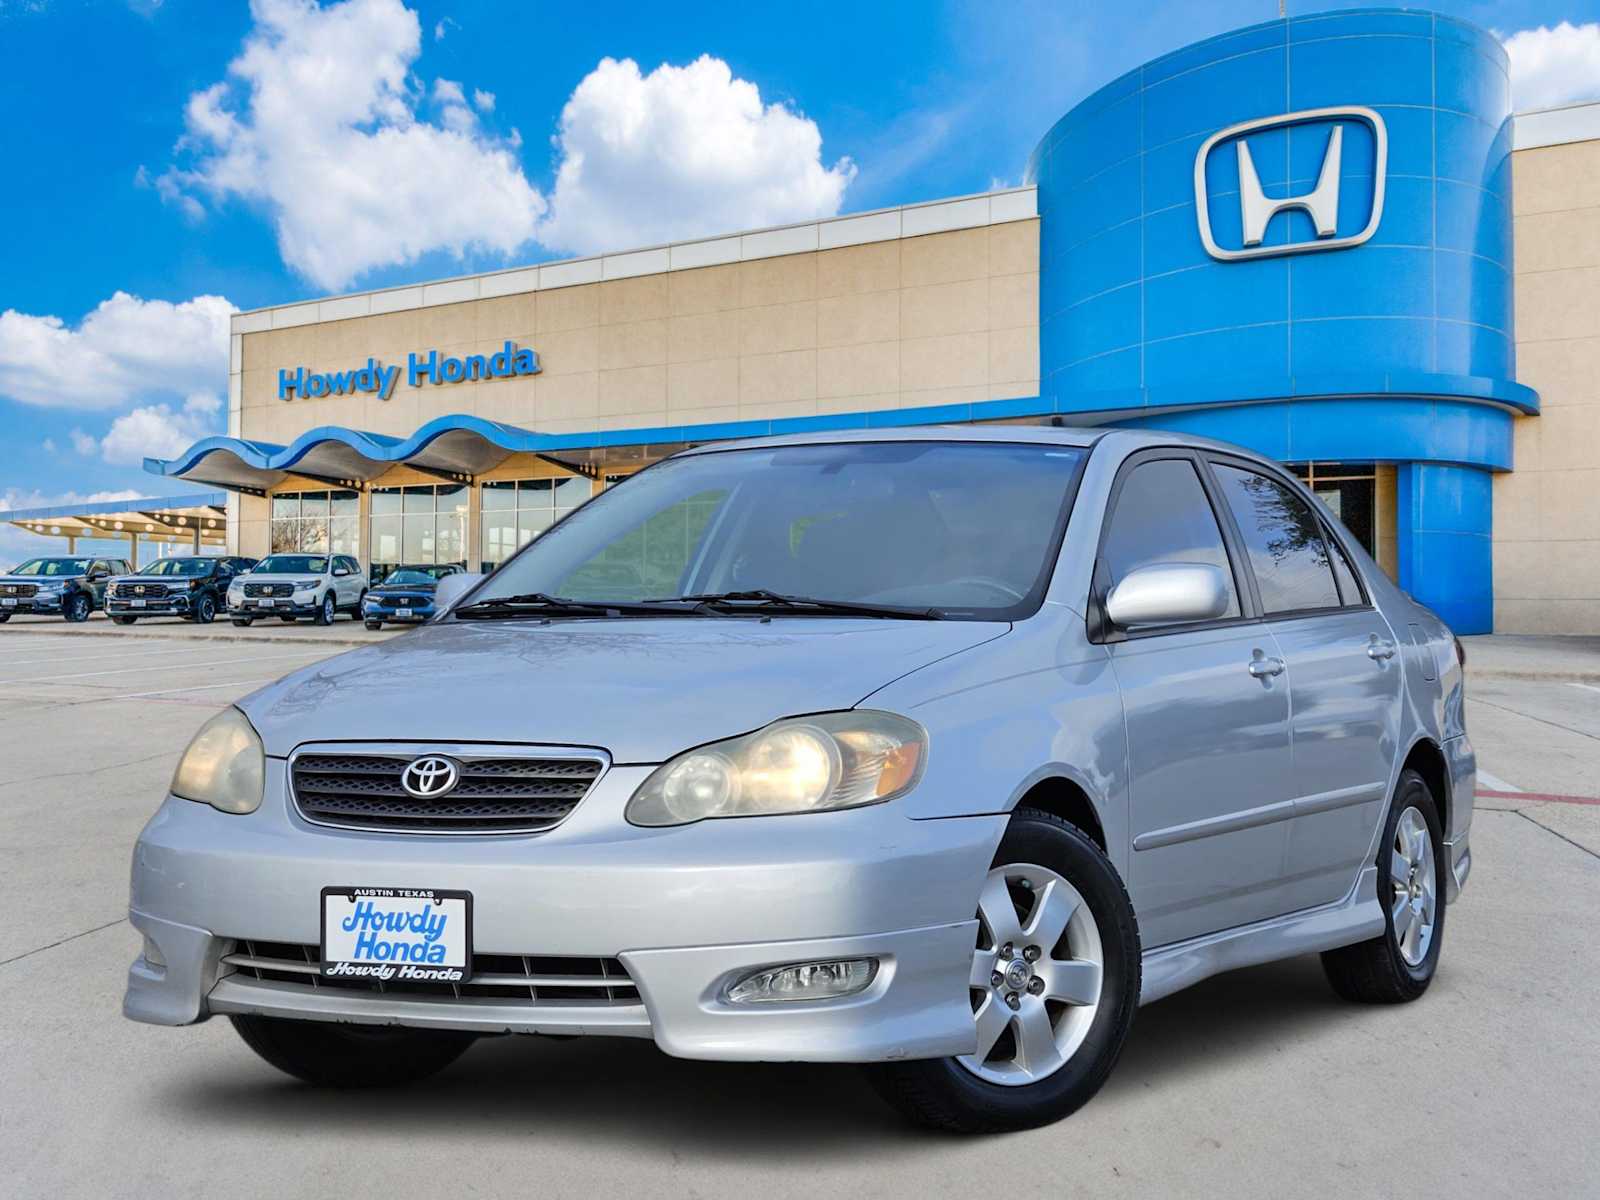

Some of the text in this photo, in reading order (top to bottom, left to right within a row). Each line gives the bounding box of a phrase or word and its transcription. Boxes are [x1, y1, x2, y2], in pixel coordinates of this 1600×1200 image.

[278, 340, 542, 401] Howdy Honda
[354, 888, 435, 898] AUSTIN TEXAS
[342, 901, 448, 942] Howdy
[353, 931, 447, 964] Honda
[326, 962, 463, 981] Howdy Honda
